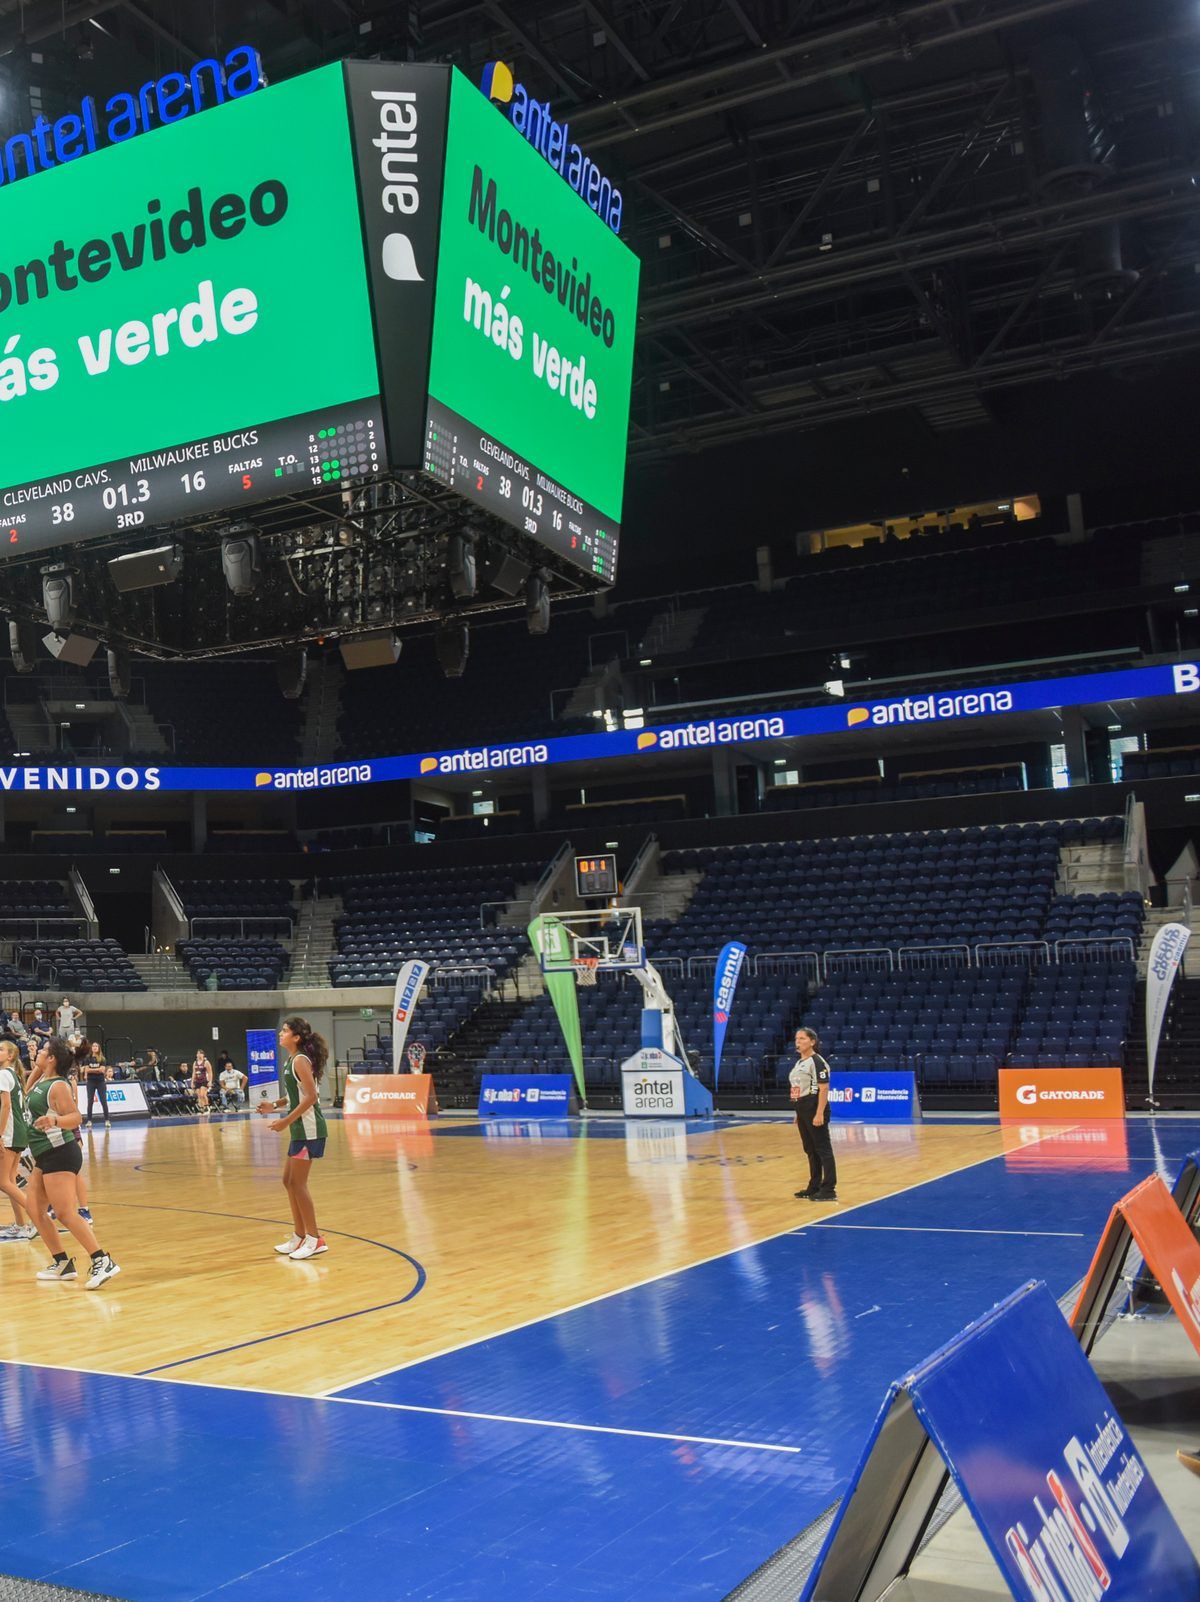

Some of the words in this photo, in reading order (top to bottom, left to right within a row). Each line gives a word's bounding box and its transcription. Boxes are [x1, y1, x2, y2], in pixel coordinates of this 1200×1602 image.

[106, 45, 262, 143] arena
[372, 91, 419, 214] antel
[511, 83, 569, 177] antel
[567, 144, 623, 234] arena
[468, 164, 615, 349] Montevideo
[77, 280, 258, 376] verde
[463, 277, 524, 361] más
[532, 331, 597, 419] verde
[309, 434, 315, 443] 8
[367, 420, 374, 428] 0
[309, 444, 318, 453] 12
[369, 431, 375, 439] 2
[130, 442, 210, 474] MILWAUKEE
[213, 430, 259, 454] BUCKS
[278, 455, 298, 466] T.O.
[310, 455, 319, 464] 13
[370, 442, 376, 450] 0
[311, 466, 321, 475] 14
[371, 453, 377, 461] 0
[479, 437, 514, 471] CLEVELAND
[513, 459, 530, 481] CAVS.
[228, 458, 263, 474] FALTAS
[312, 477, 322, 485] 15
[372, 464, 379, 472] 0
[473, 459, 489, 476] FALTAS
[3, 478, 72, 506] CLEVELAND
[75, 469, 111, 493] CAVS.
[242, 475, 252, 490] 5
[475, 476, 483, 490] 2
[536, 474, 567, 504] MILWAUKEE
[566, 491, 583, 515] BUCKS
[51, 502, 75, 525] 38
[102, 479, 151, 510] 01.3
[181, 471, 206, 494] 16
[499, 476, 512, 498] 38
[522, 486, 543, 516] 01.3
[552, 510, 562, 530] 16
[116, 511, 145, 529] 3RD
[524, 516, 537, 534] 3RD
[9, 529, 19, 543] 2
[571, 536, 577, 548] 5
[872, 695, 936, 726] antel
[939, 690, 1013, 717] arena
[659, 722, 715, 749] antel
[718, 716, 784, 742] arena
[439, 748, 489, 773] antel
[490, 744, 547, 767] arena
[274, 768, 319, 789] antel
[320, 763, 372, 787] arena
[401, 966, 422, 1008] 1727
[717, 947, 740, 1009] casmu
[372, 1092, 416, 1100] GATORADE
[634, 1080, 673, 1095] antel
[1040, 1091, 1104, 1099] GATORADE
[635, 1097, 673, 1108] arena
